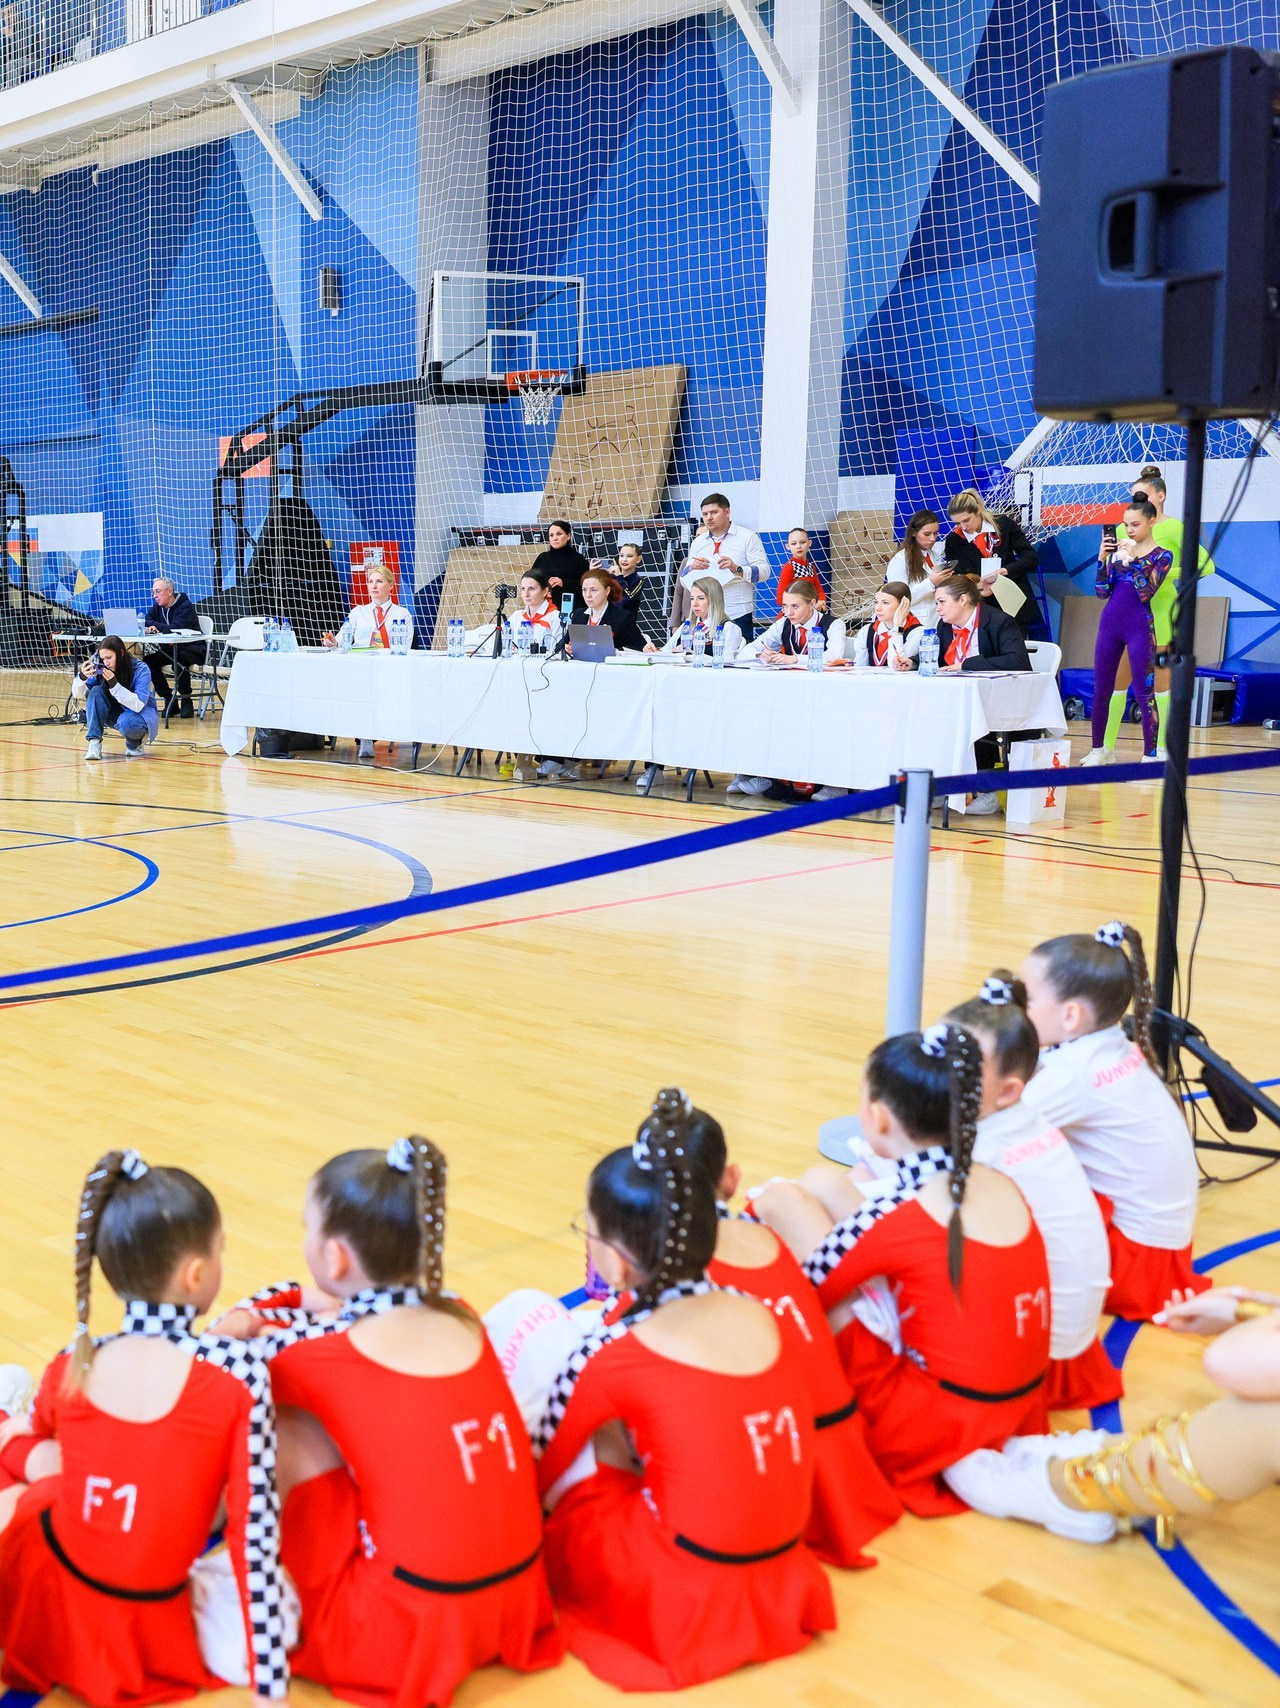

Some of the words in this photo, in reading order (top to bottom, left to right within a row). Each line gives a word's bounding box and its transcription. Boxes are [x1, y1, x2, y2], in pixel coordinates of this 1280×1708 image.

[1014, 1286, 1048, 1338] F1
[451, 1412, 517, 1484] F1
[743, 1406, 801, 1475] F1
[83, 1475, 137, 1533] F1
